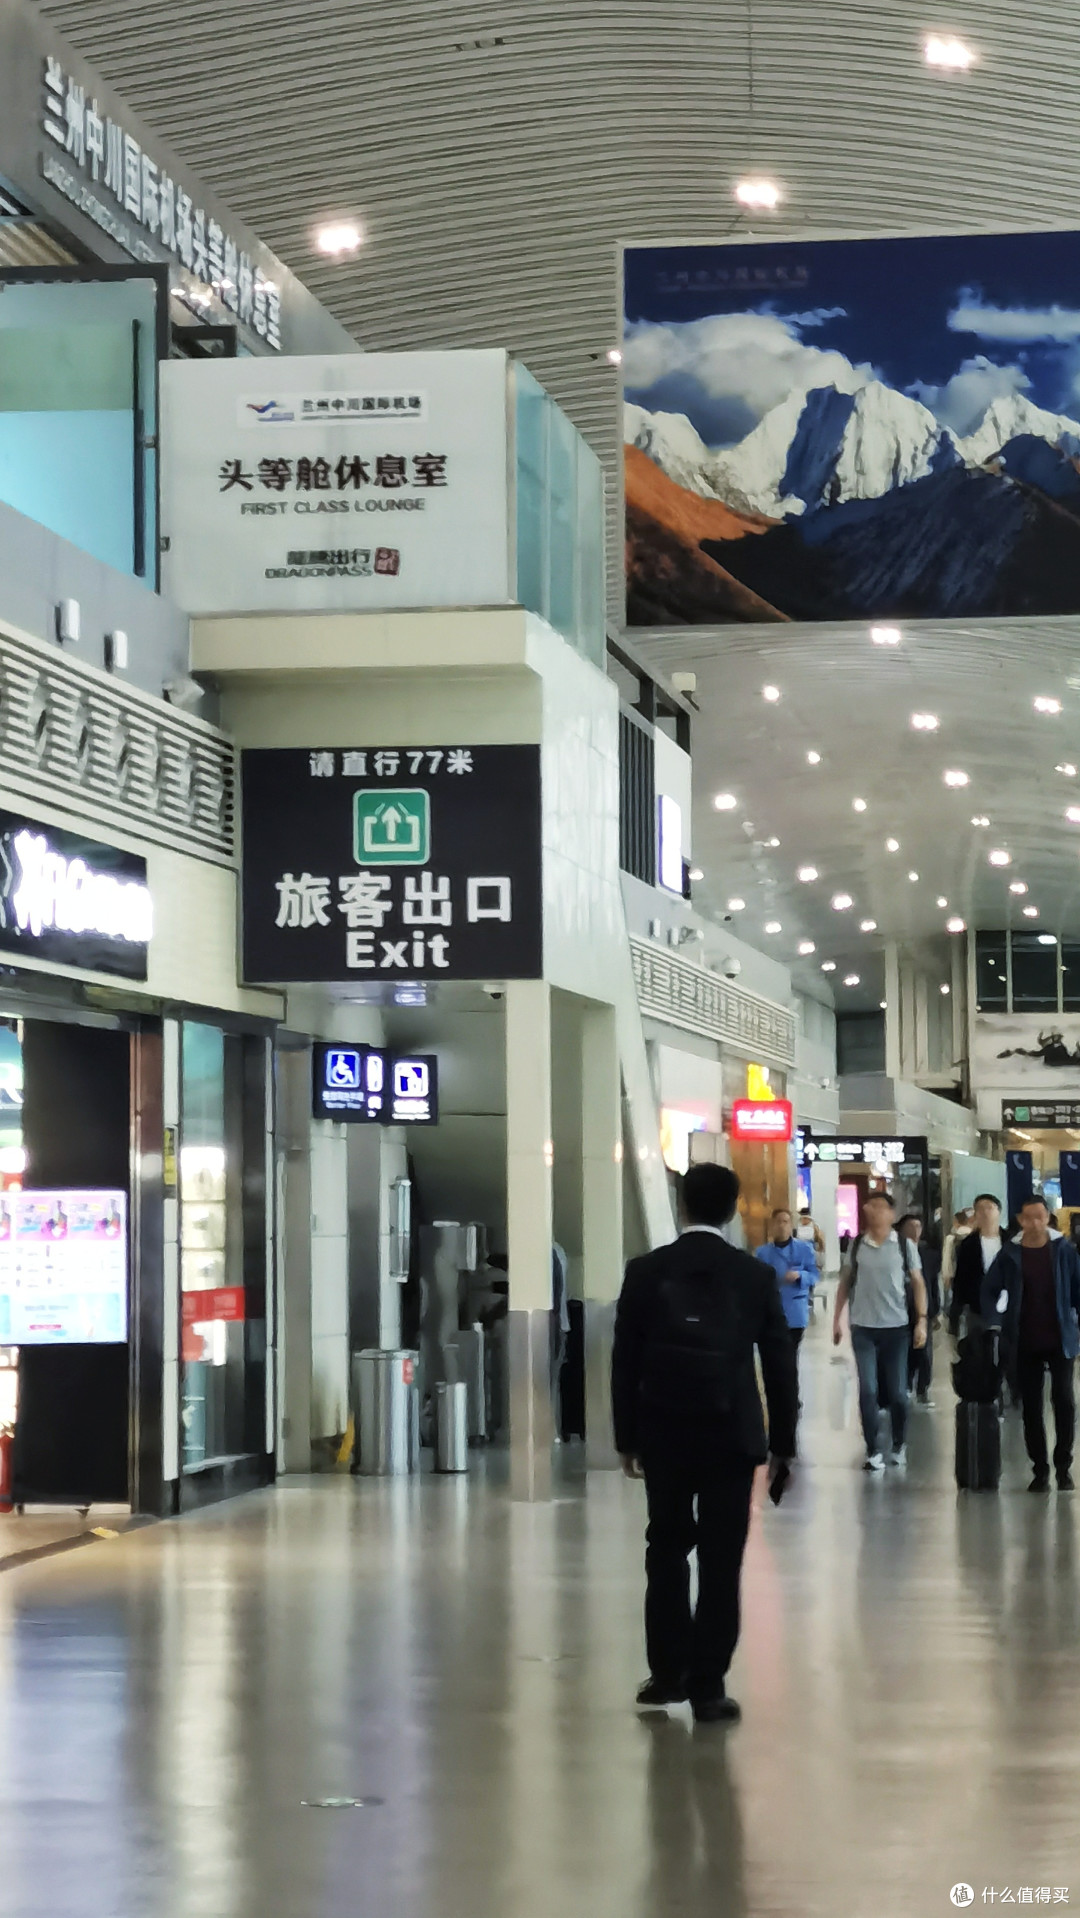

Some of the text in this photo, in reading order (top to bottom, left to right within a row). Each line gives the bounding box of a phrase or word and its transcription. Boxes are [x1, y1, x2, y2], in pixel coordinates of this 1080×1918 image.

[218, 452, 448, 492] 头等舱休息室
[240, 497, 426, 516] FIRST CLASS LOUNGE
[309, 750, 474, 777] 请直行77米
[274, 871, 513, 929] 旅客出口
[345, 930, 450, 969] Exit
